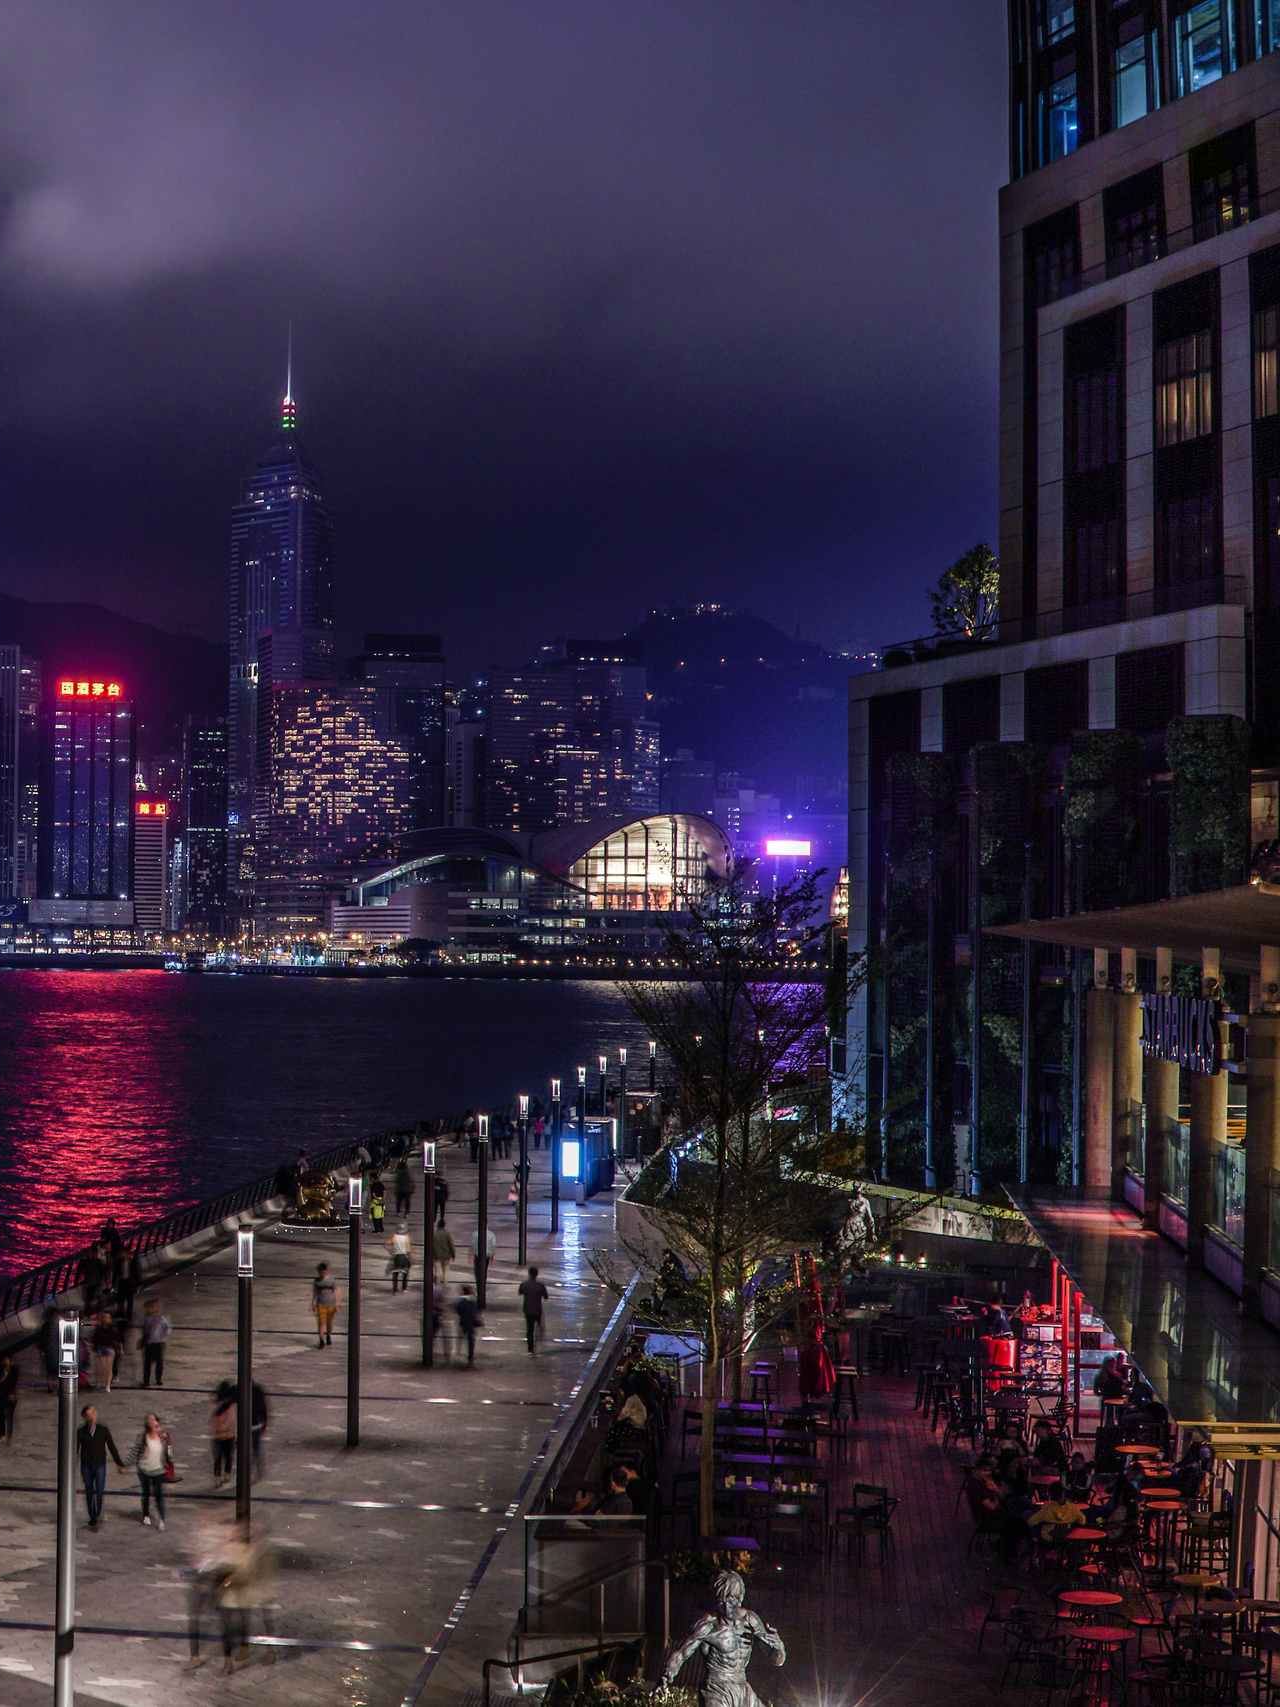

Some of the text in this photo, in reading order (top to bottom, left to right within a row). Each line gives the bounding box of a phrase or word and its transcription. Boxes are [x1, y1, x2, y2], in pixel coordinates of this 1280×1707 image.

[61, 681, 120, 696] 国酒茅台
[1143, 992, 1216, 1076] STARBUCKS
